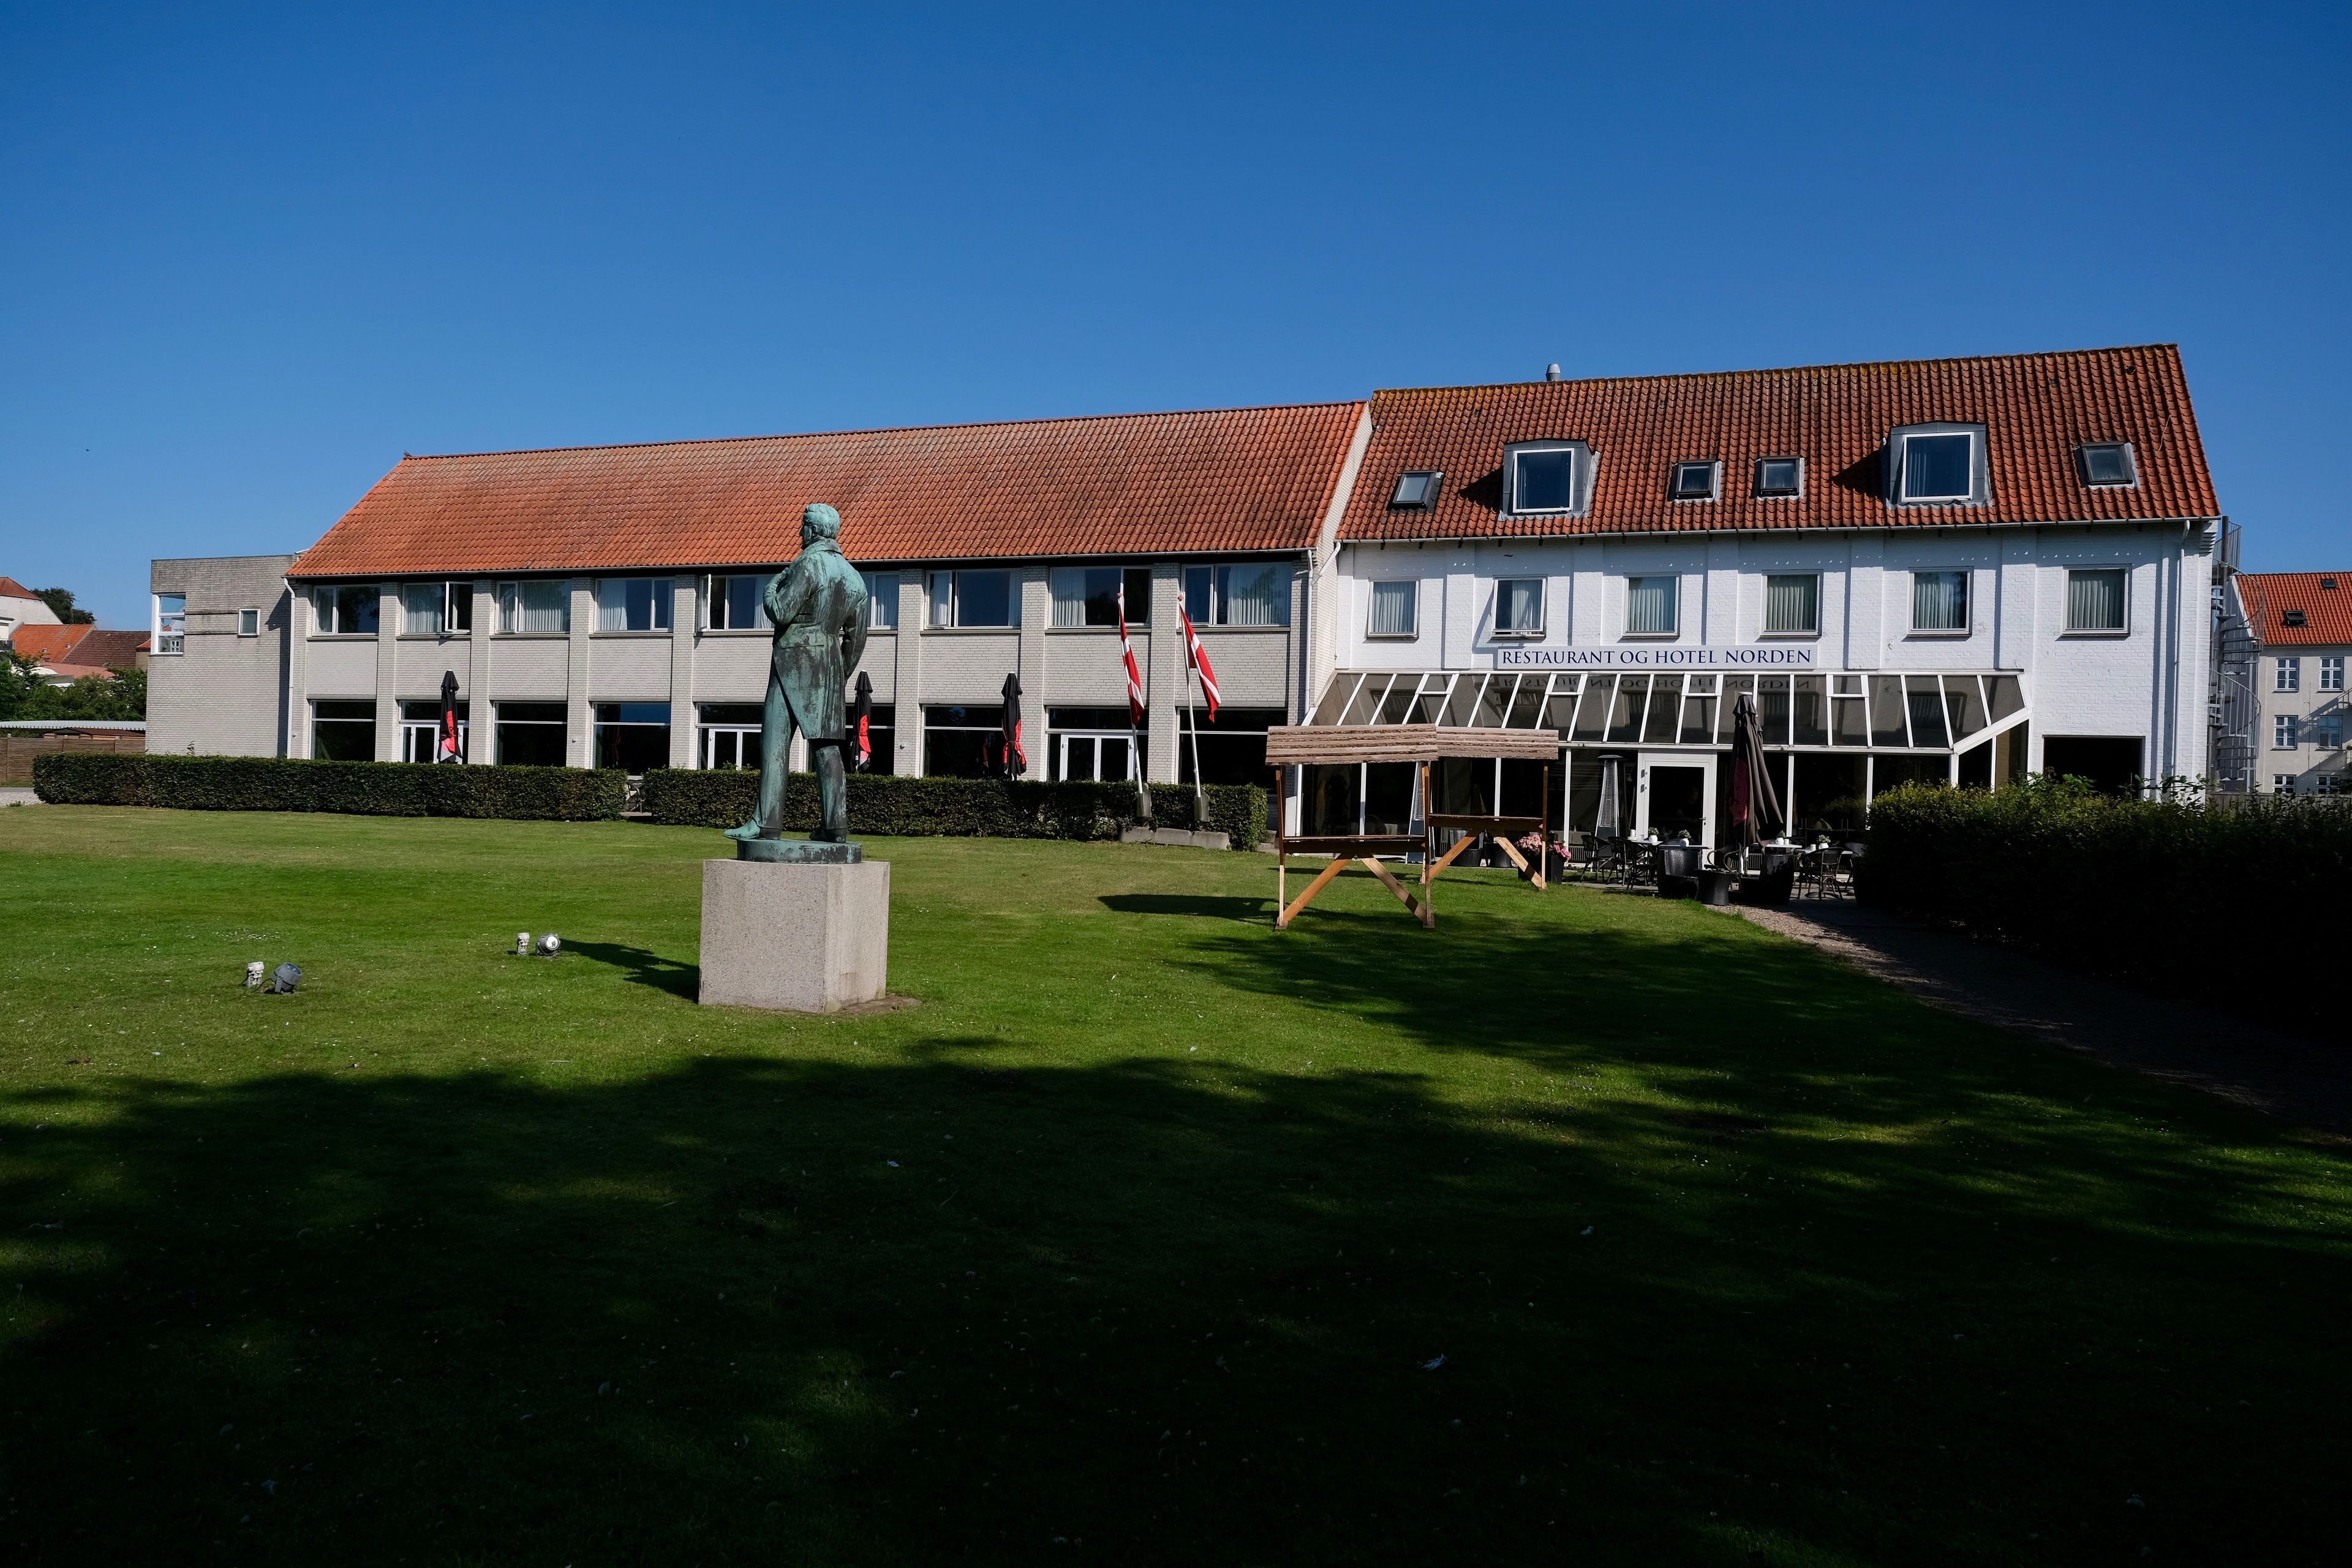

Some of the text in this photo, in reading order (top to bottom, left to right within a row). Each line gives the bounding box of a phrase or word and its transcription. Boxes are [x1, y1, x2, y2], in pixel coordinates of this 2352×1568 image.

[1502, 649, 1811, 664] RESTAURANT OG HOTEL NORDEN
